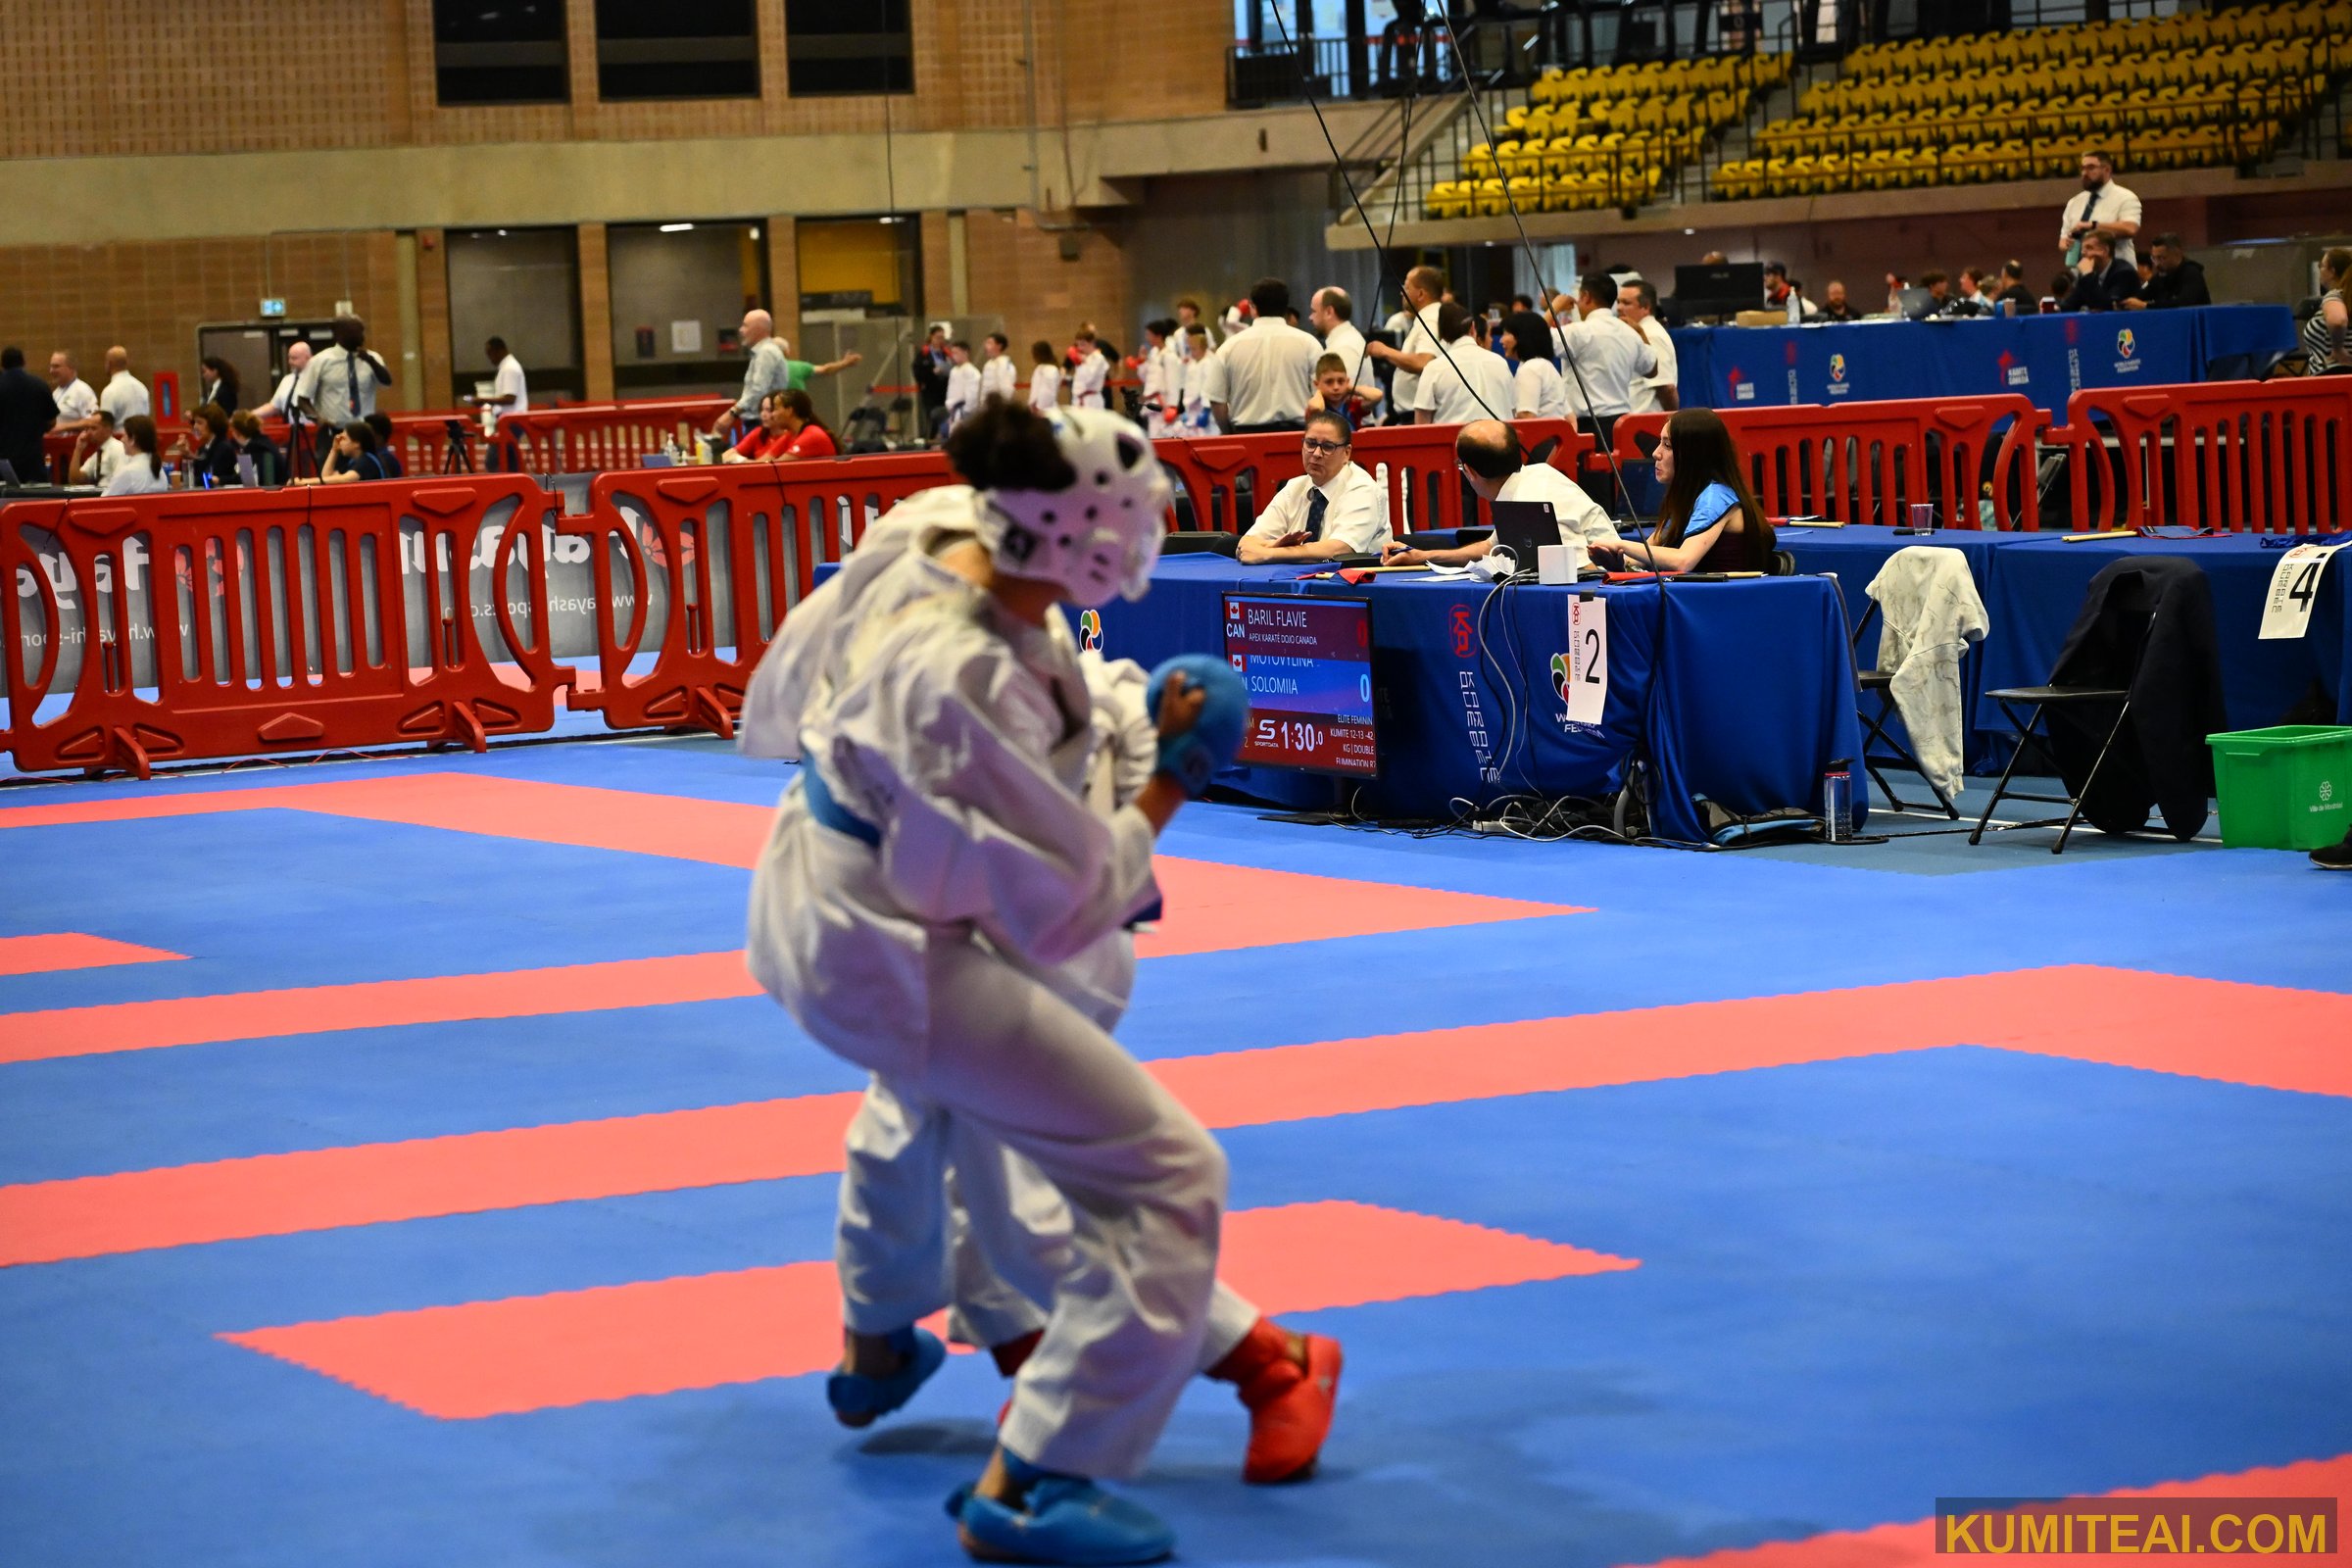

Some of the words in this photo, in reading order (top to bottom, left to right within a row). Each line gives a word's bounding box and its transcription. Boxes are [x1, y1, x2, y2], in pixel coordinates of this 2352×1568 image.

[2289, 553, 2328, 612] 4
[1249, 610, 1274, 626] BARIL
[1277, 611, 1307, 627] FLAVIE
[1227, 623, 1245, 638] CAN
[1296, 635, 1317, 645] CANADA
[1585, 628, 1600, 684] 2
[1251, 675, 1298, 695] SOLOMIIA
[1360, 673, 1371, 703] 0
[1330, 728, 1348, 738] KUMITE
[1343, 743, 1350, 753] KG
[1353, 745, 1374, 755] DOUBLE
